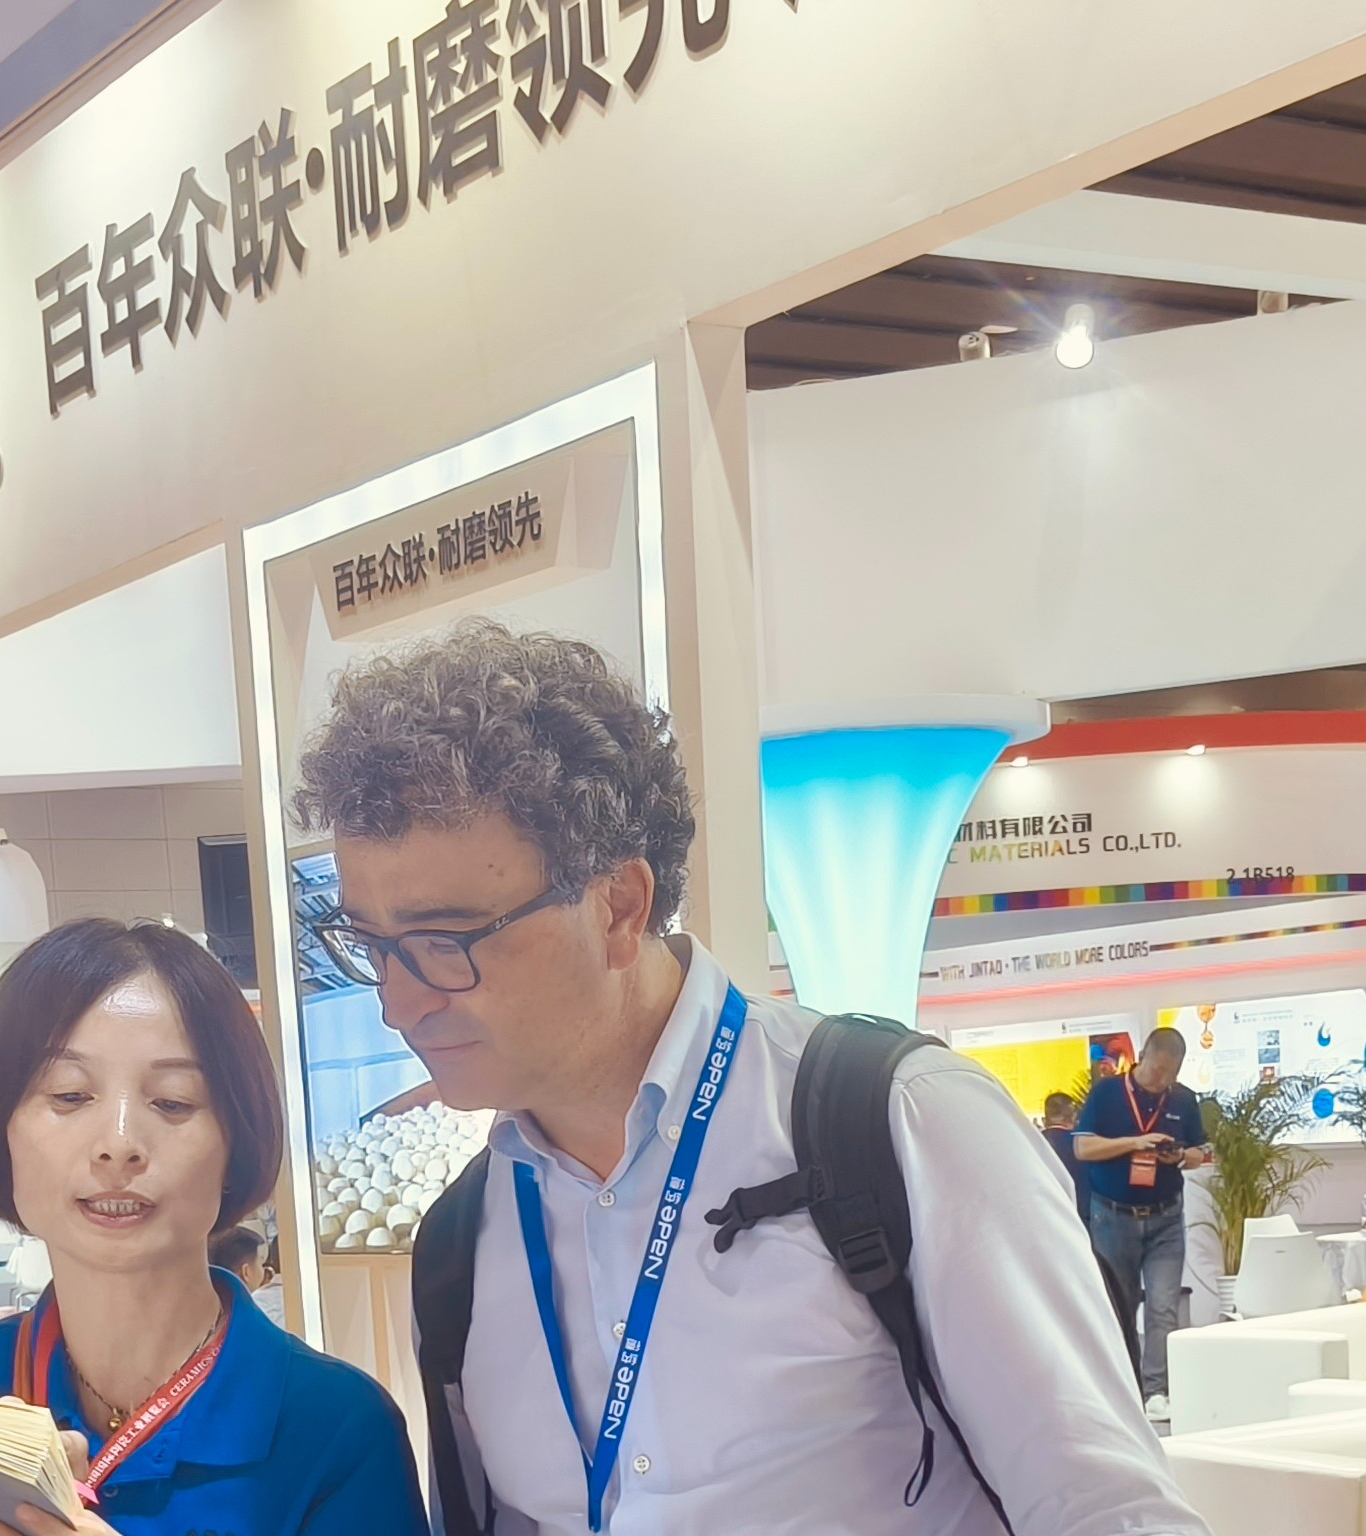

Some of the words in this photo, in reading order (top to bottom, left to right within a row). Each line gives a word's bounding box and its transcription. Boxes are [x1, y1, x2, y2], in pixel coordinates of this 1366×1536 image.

[332, 491, 542, 612] 百年众联·耐磨领先
[970, 837, 1090, 863] MATERIALS
[1075, 946, 1104, 964] MORE
[1108, 941, 1149, 960] COLORS
